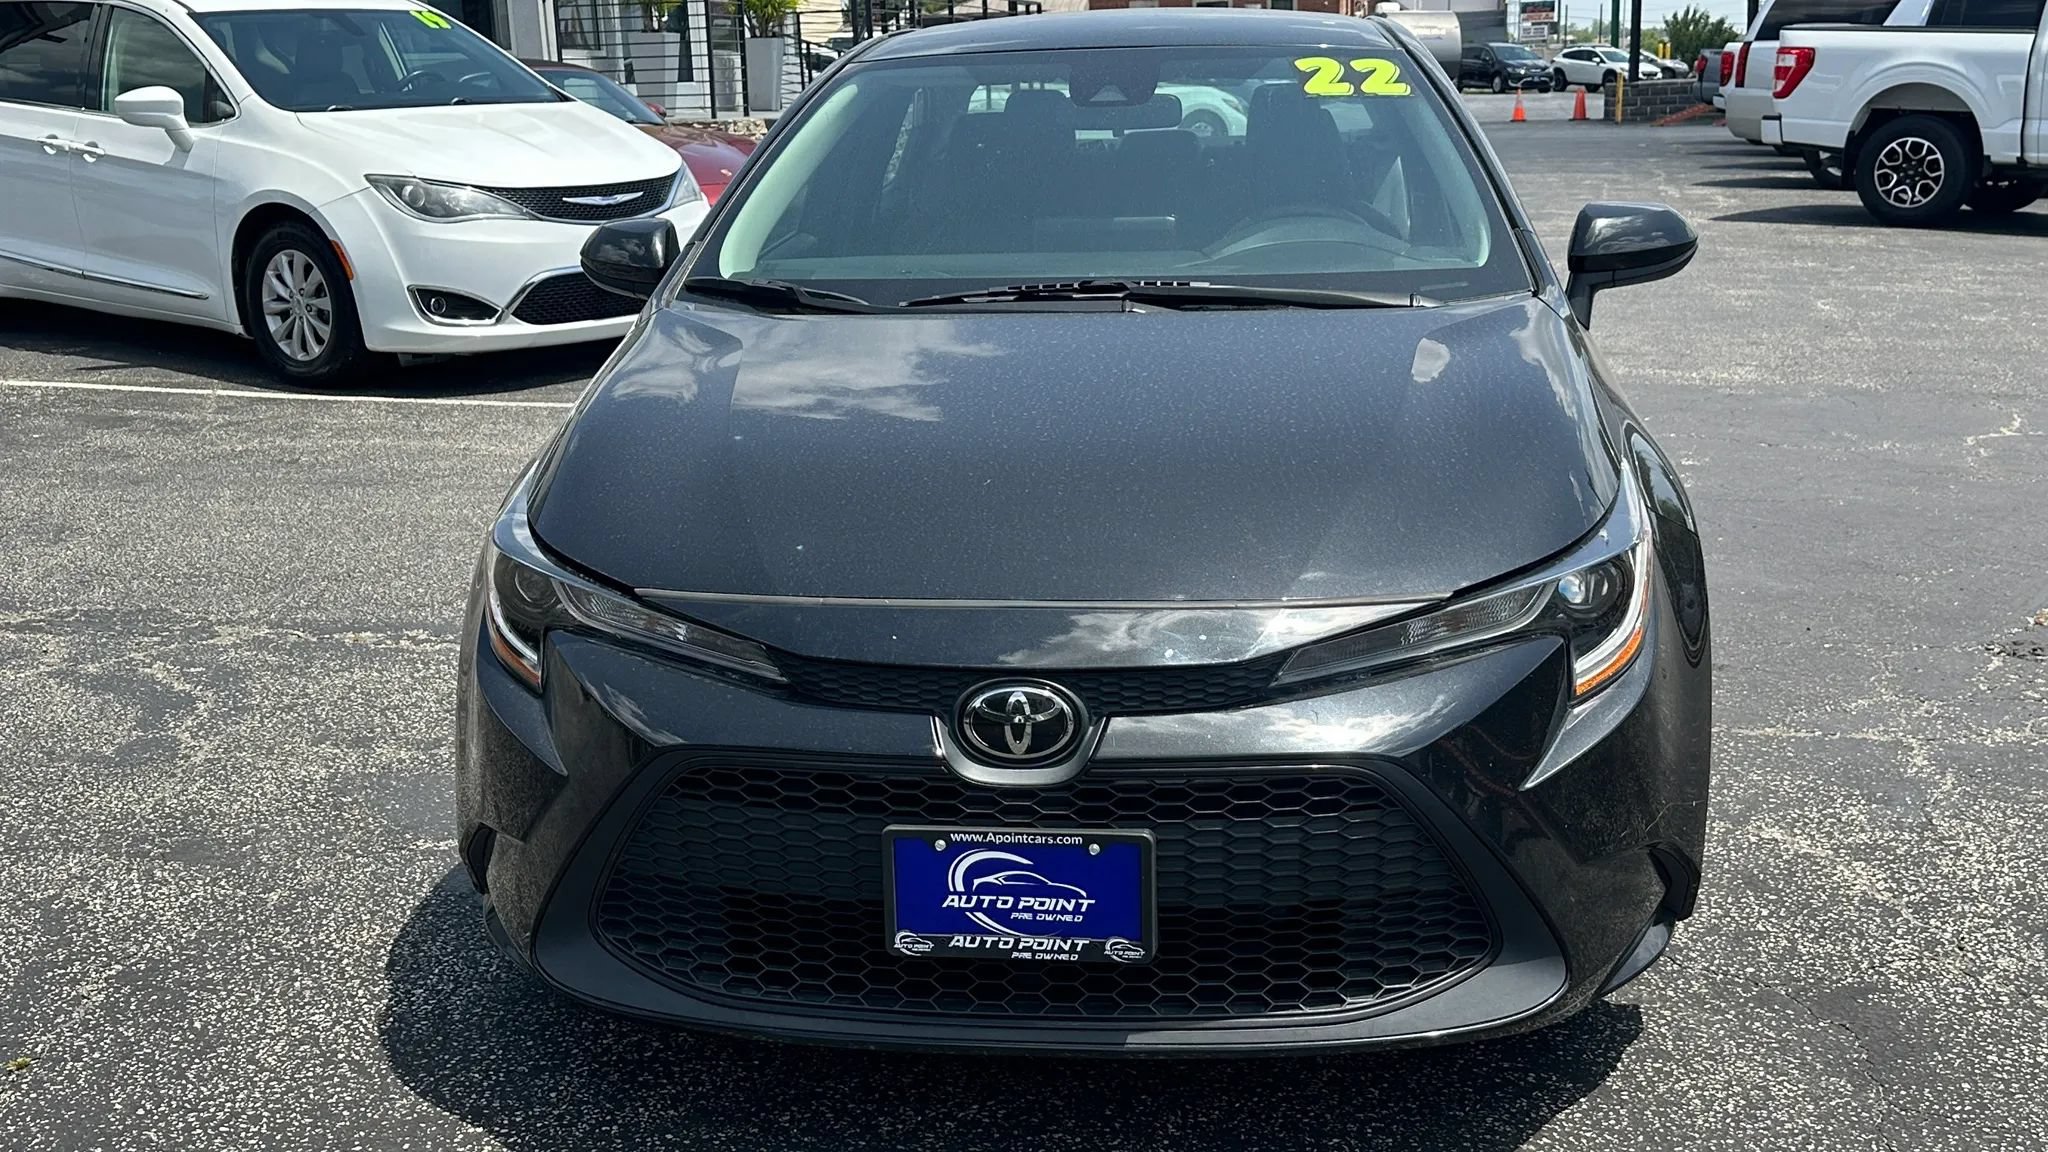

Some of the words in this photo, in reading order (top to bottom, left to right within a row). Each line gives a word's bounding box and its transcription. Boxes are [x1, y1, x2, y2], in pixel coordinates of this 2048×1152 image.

[1294, 56, 1412, 96] 22
[950, 832, 1083, 845] www.Apointcars.com
[942, 895, 1014, 909] AUTO
[1017, 897, 1096, 912] POINT
[1010, 912, 1033, 920] PRE
[1036, 913, 1083, 922] OWNED
[948, 935, 1014, 949] AUTO
[1018, 937, 1090, 951] POINT
[1011, 951, 1032, 959] PRE
[1035, 952, 1079, 960] OWNED
